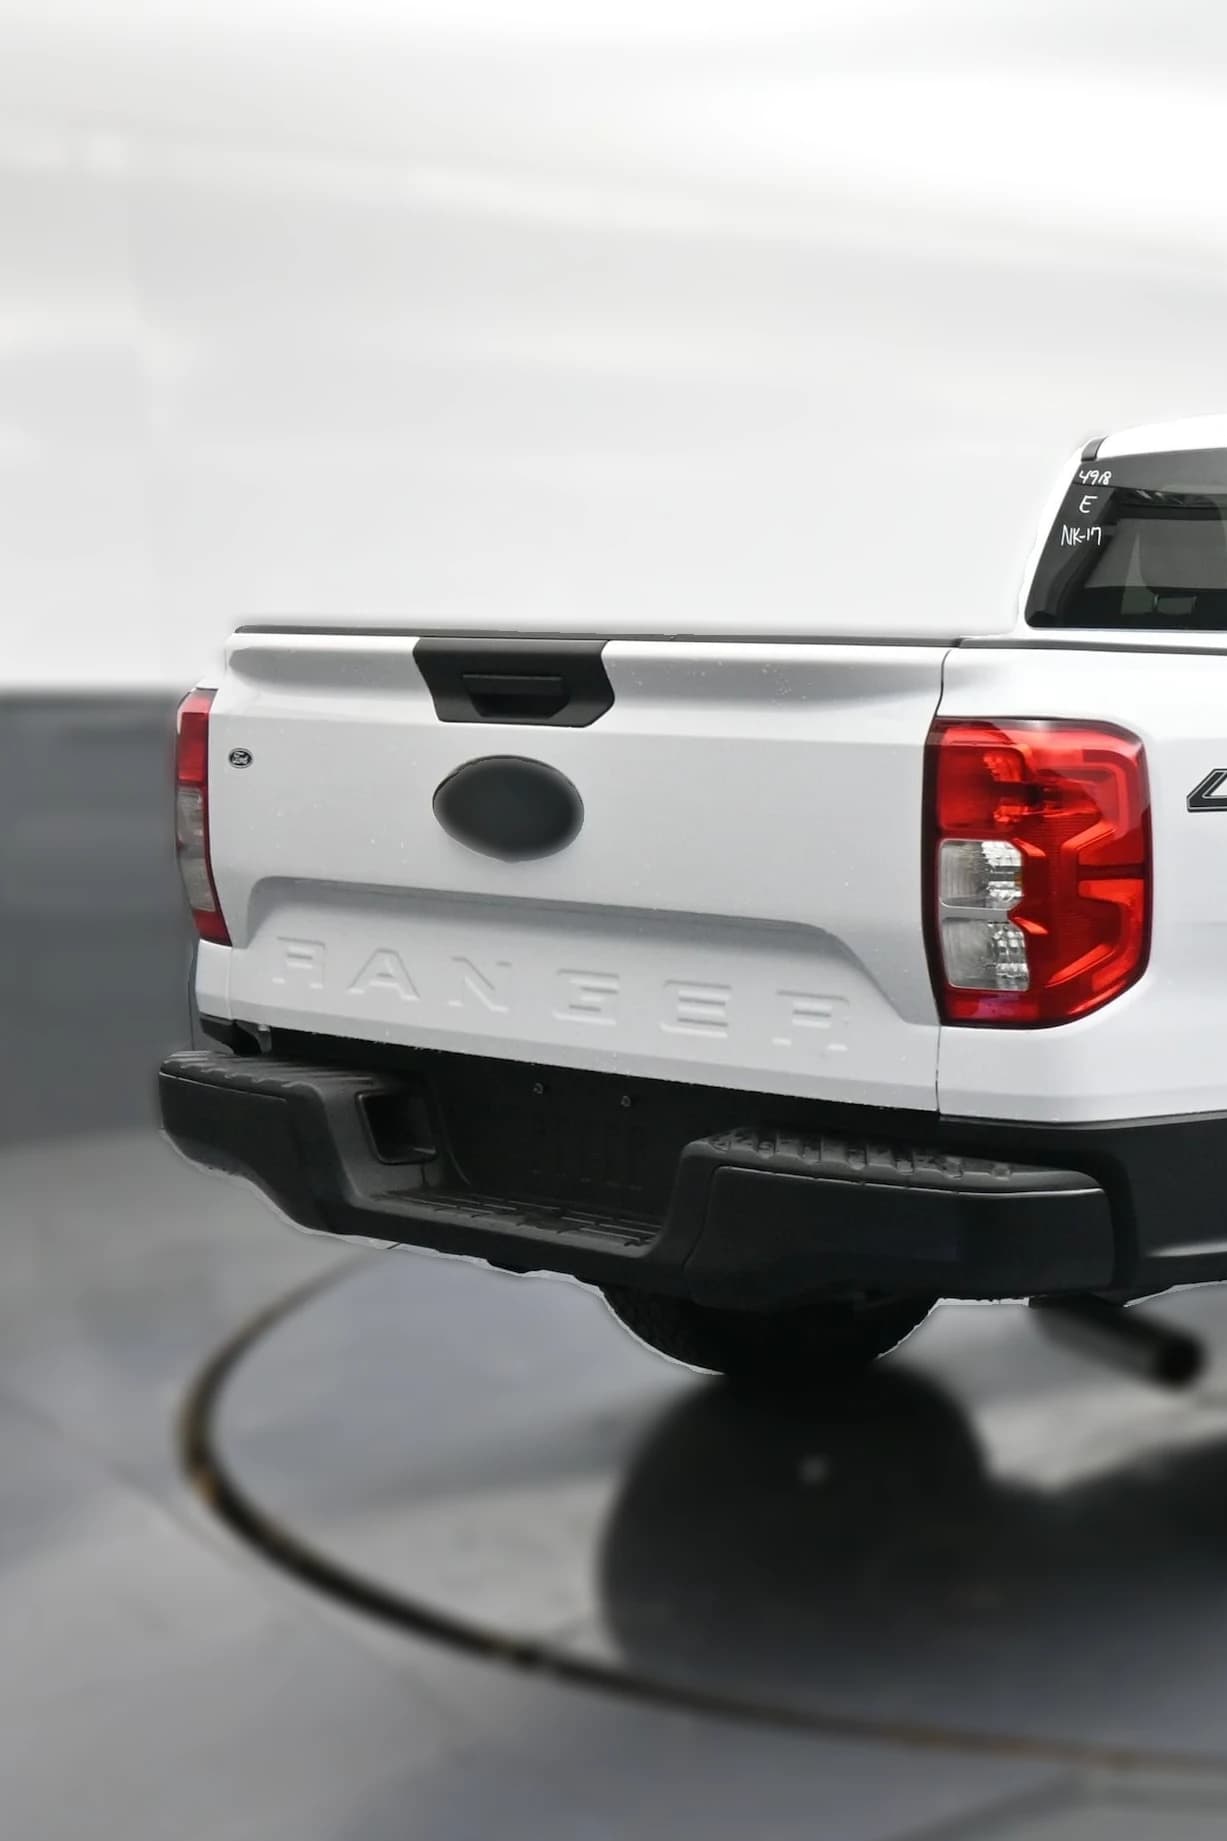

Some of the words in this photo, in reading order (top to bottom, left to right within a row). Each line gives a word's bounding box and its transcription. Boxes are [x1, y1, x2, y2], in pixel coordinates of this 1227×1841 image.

[1079, 495, 1098, 513] E
[1061, 524, 1101, 546] NK-17
[272, 936, 850, 1052] RANGER
